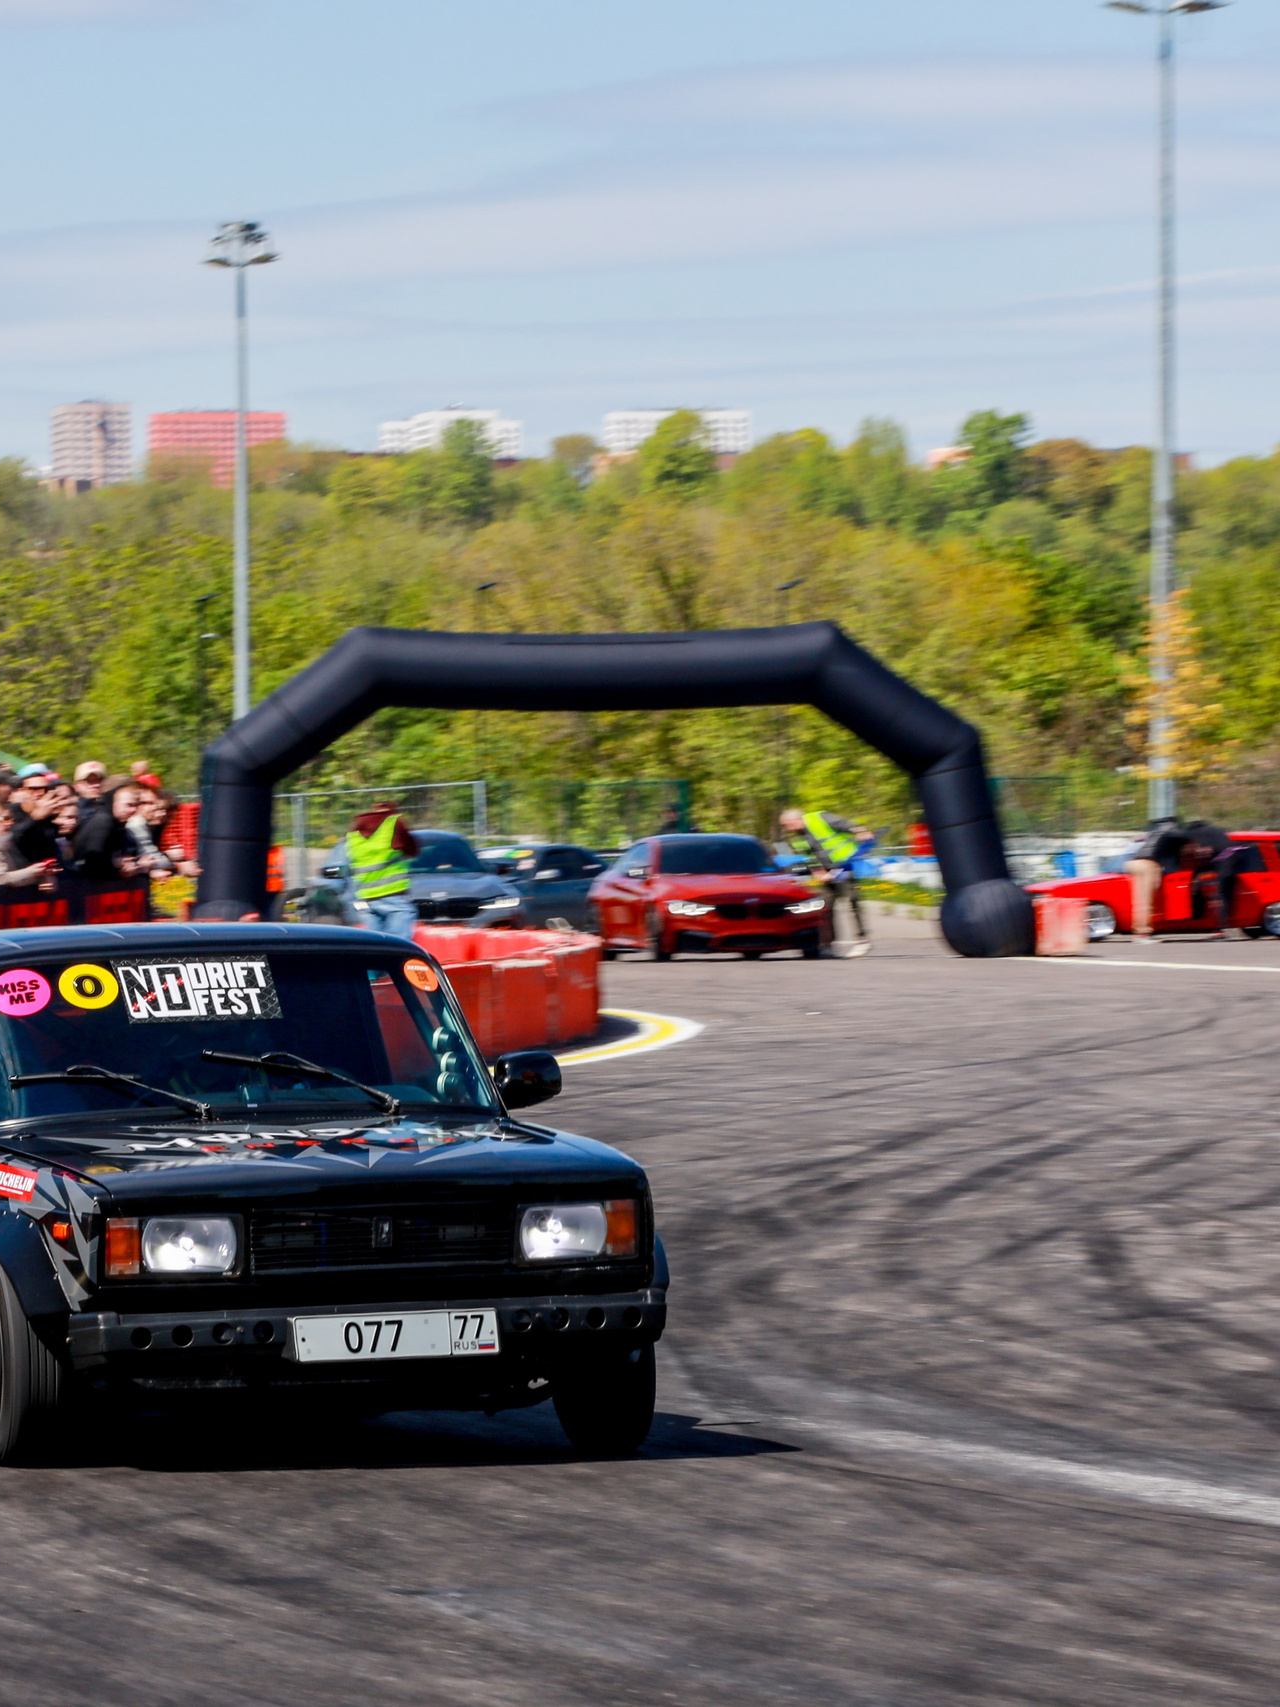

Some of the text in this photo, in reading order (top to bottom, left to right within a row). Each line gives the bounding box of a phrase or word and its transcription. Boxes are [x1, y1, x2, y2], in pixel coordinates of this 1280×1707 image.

[186, 962, 267, 988] DRIFT
[9, 992, 36, 1006] ME
[192, 988, 263, 1016] FEST
[344, 1319, 403, 1353] 077
[454, 1314, 484, 1340] 77
[454, 1341, 477, 1350] RUS
